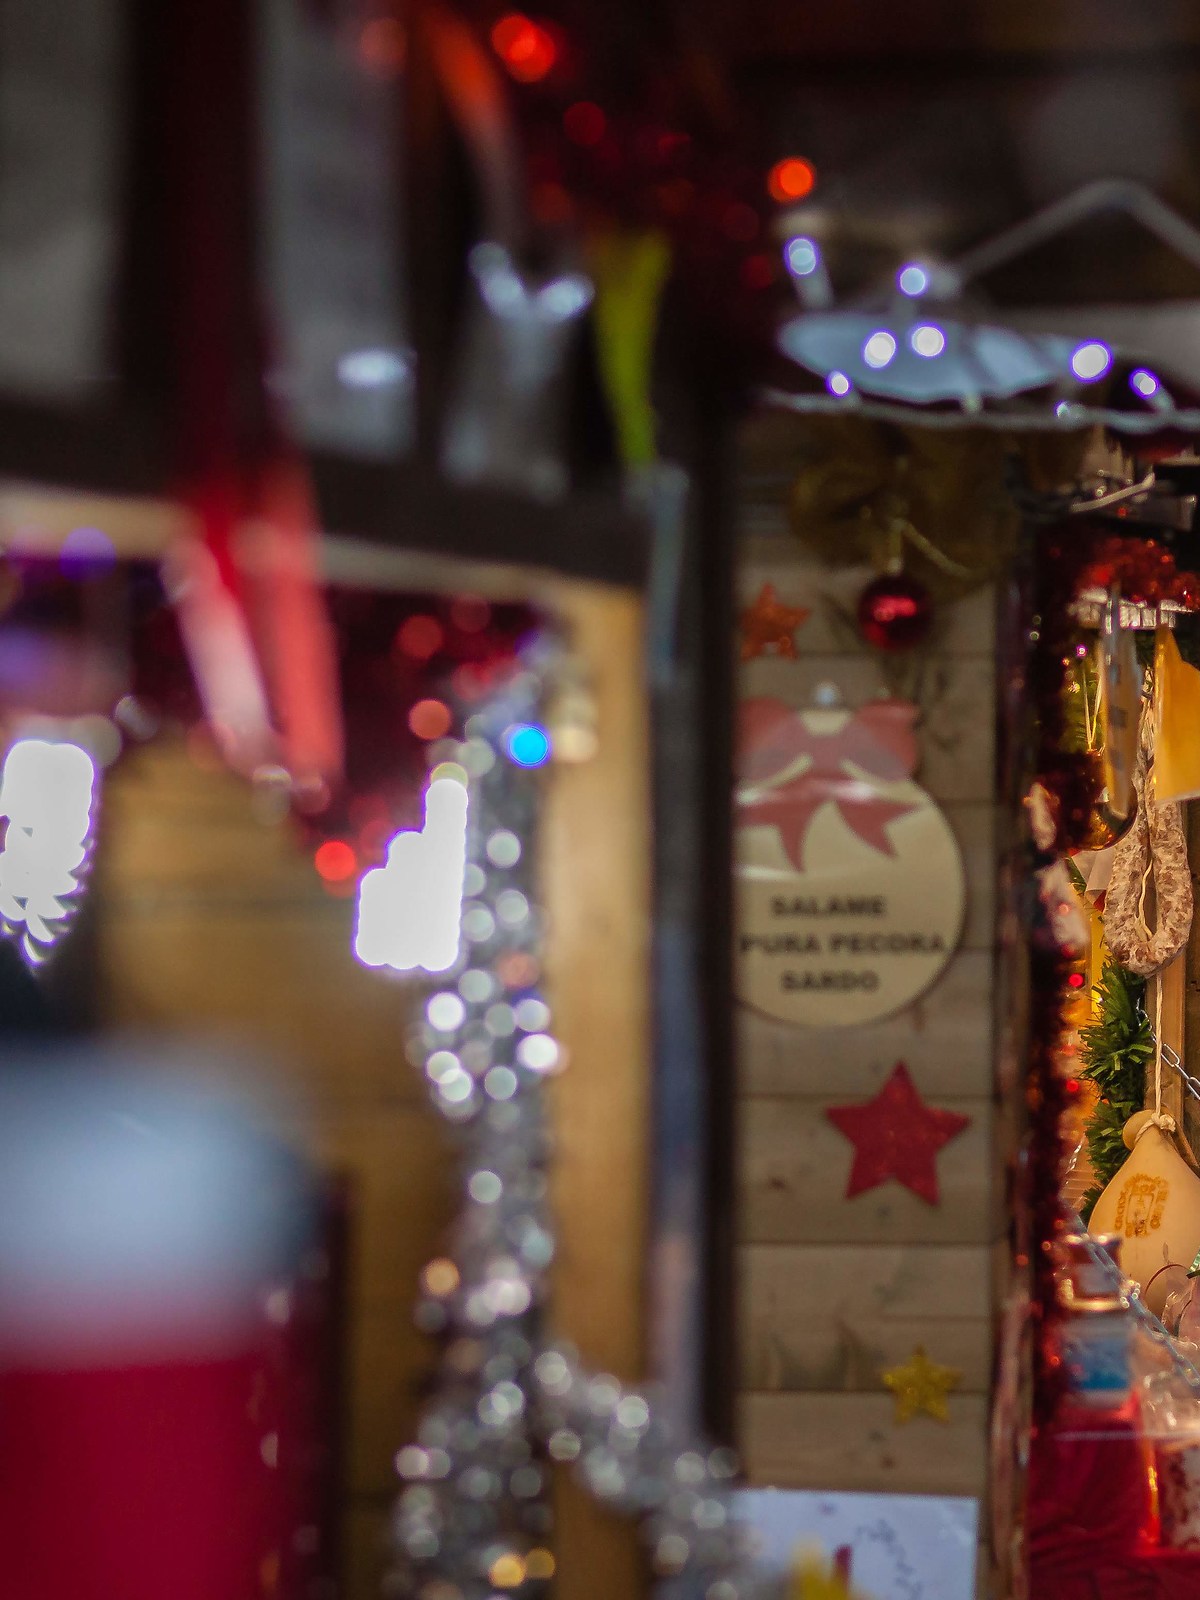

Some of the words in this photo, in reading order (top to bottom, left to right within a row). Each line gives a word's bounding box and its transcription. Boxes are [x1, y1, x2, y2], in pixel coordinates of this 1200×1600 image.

[771, 896, 886, 918] SALAME
[738, 934, 821, 954] PURA
[828, 933, 945, 953] PECORA
[781, 969, 879, 992] SARDO
